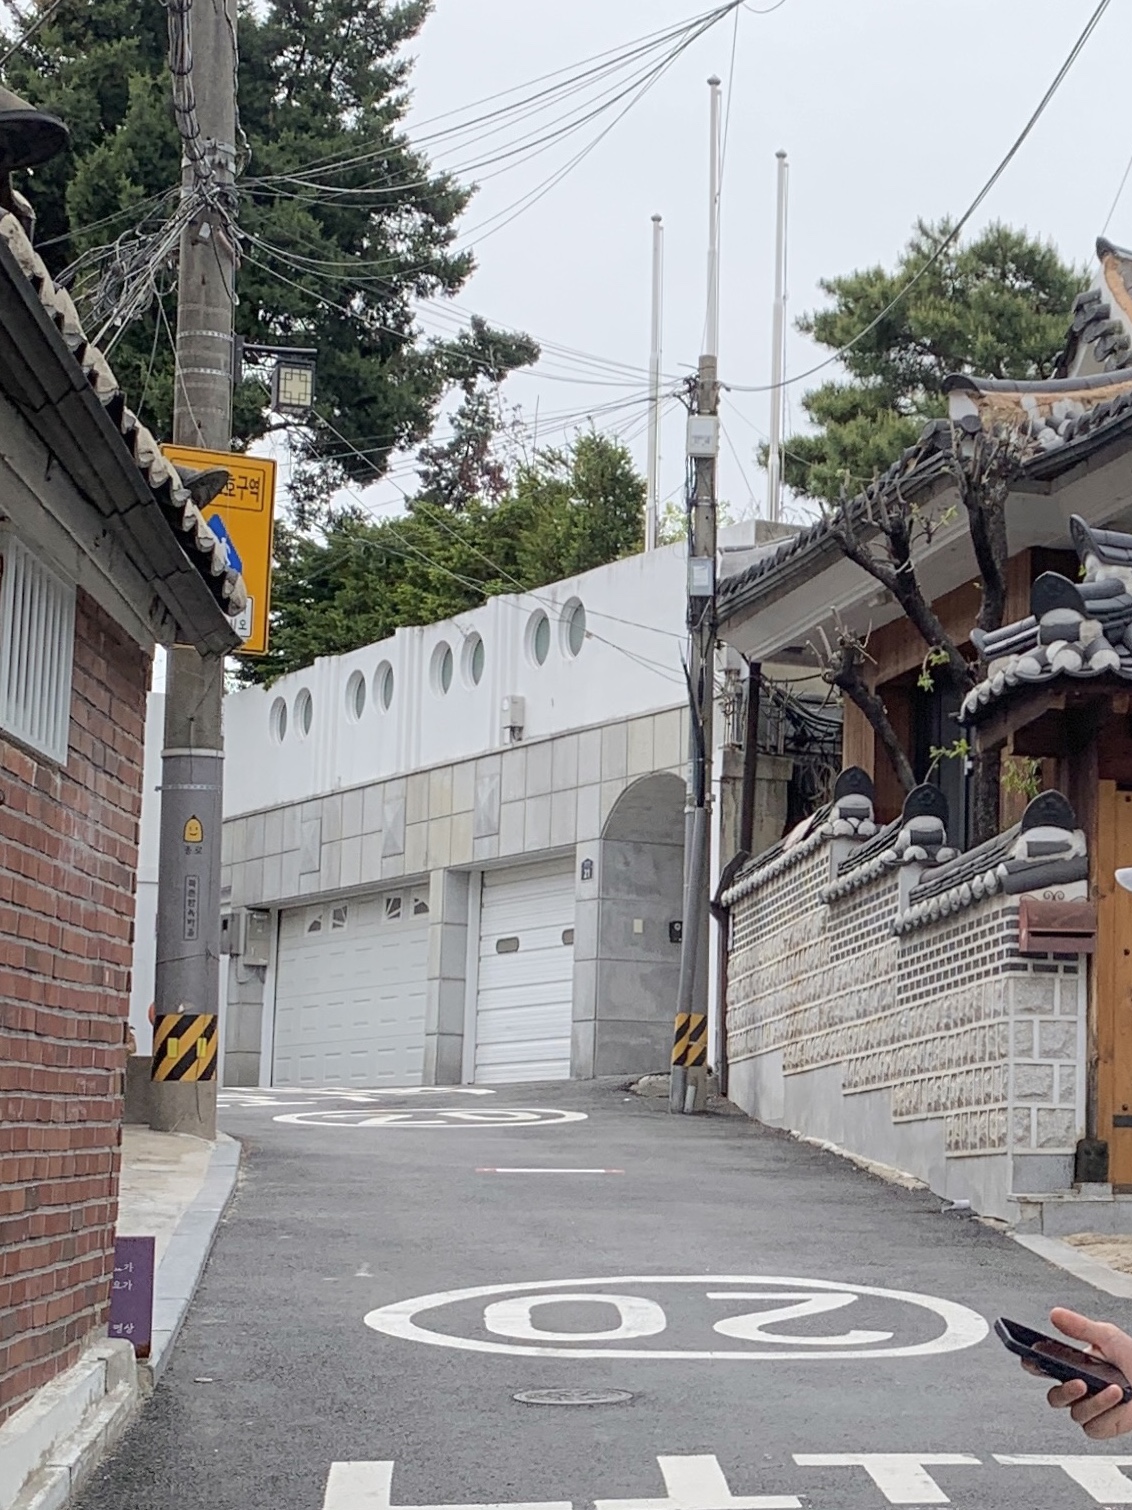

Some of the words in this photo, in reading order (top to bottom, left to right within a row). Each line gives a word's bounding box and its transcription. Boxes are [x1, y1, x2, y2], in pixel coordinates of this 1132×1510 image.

[112, 1280, 133, 1291] 요가
[485, 1291, 893, 1346] 20
[113, 1322, 135, 1334] 명상
